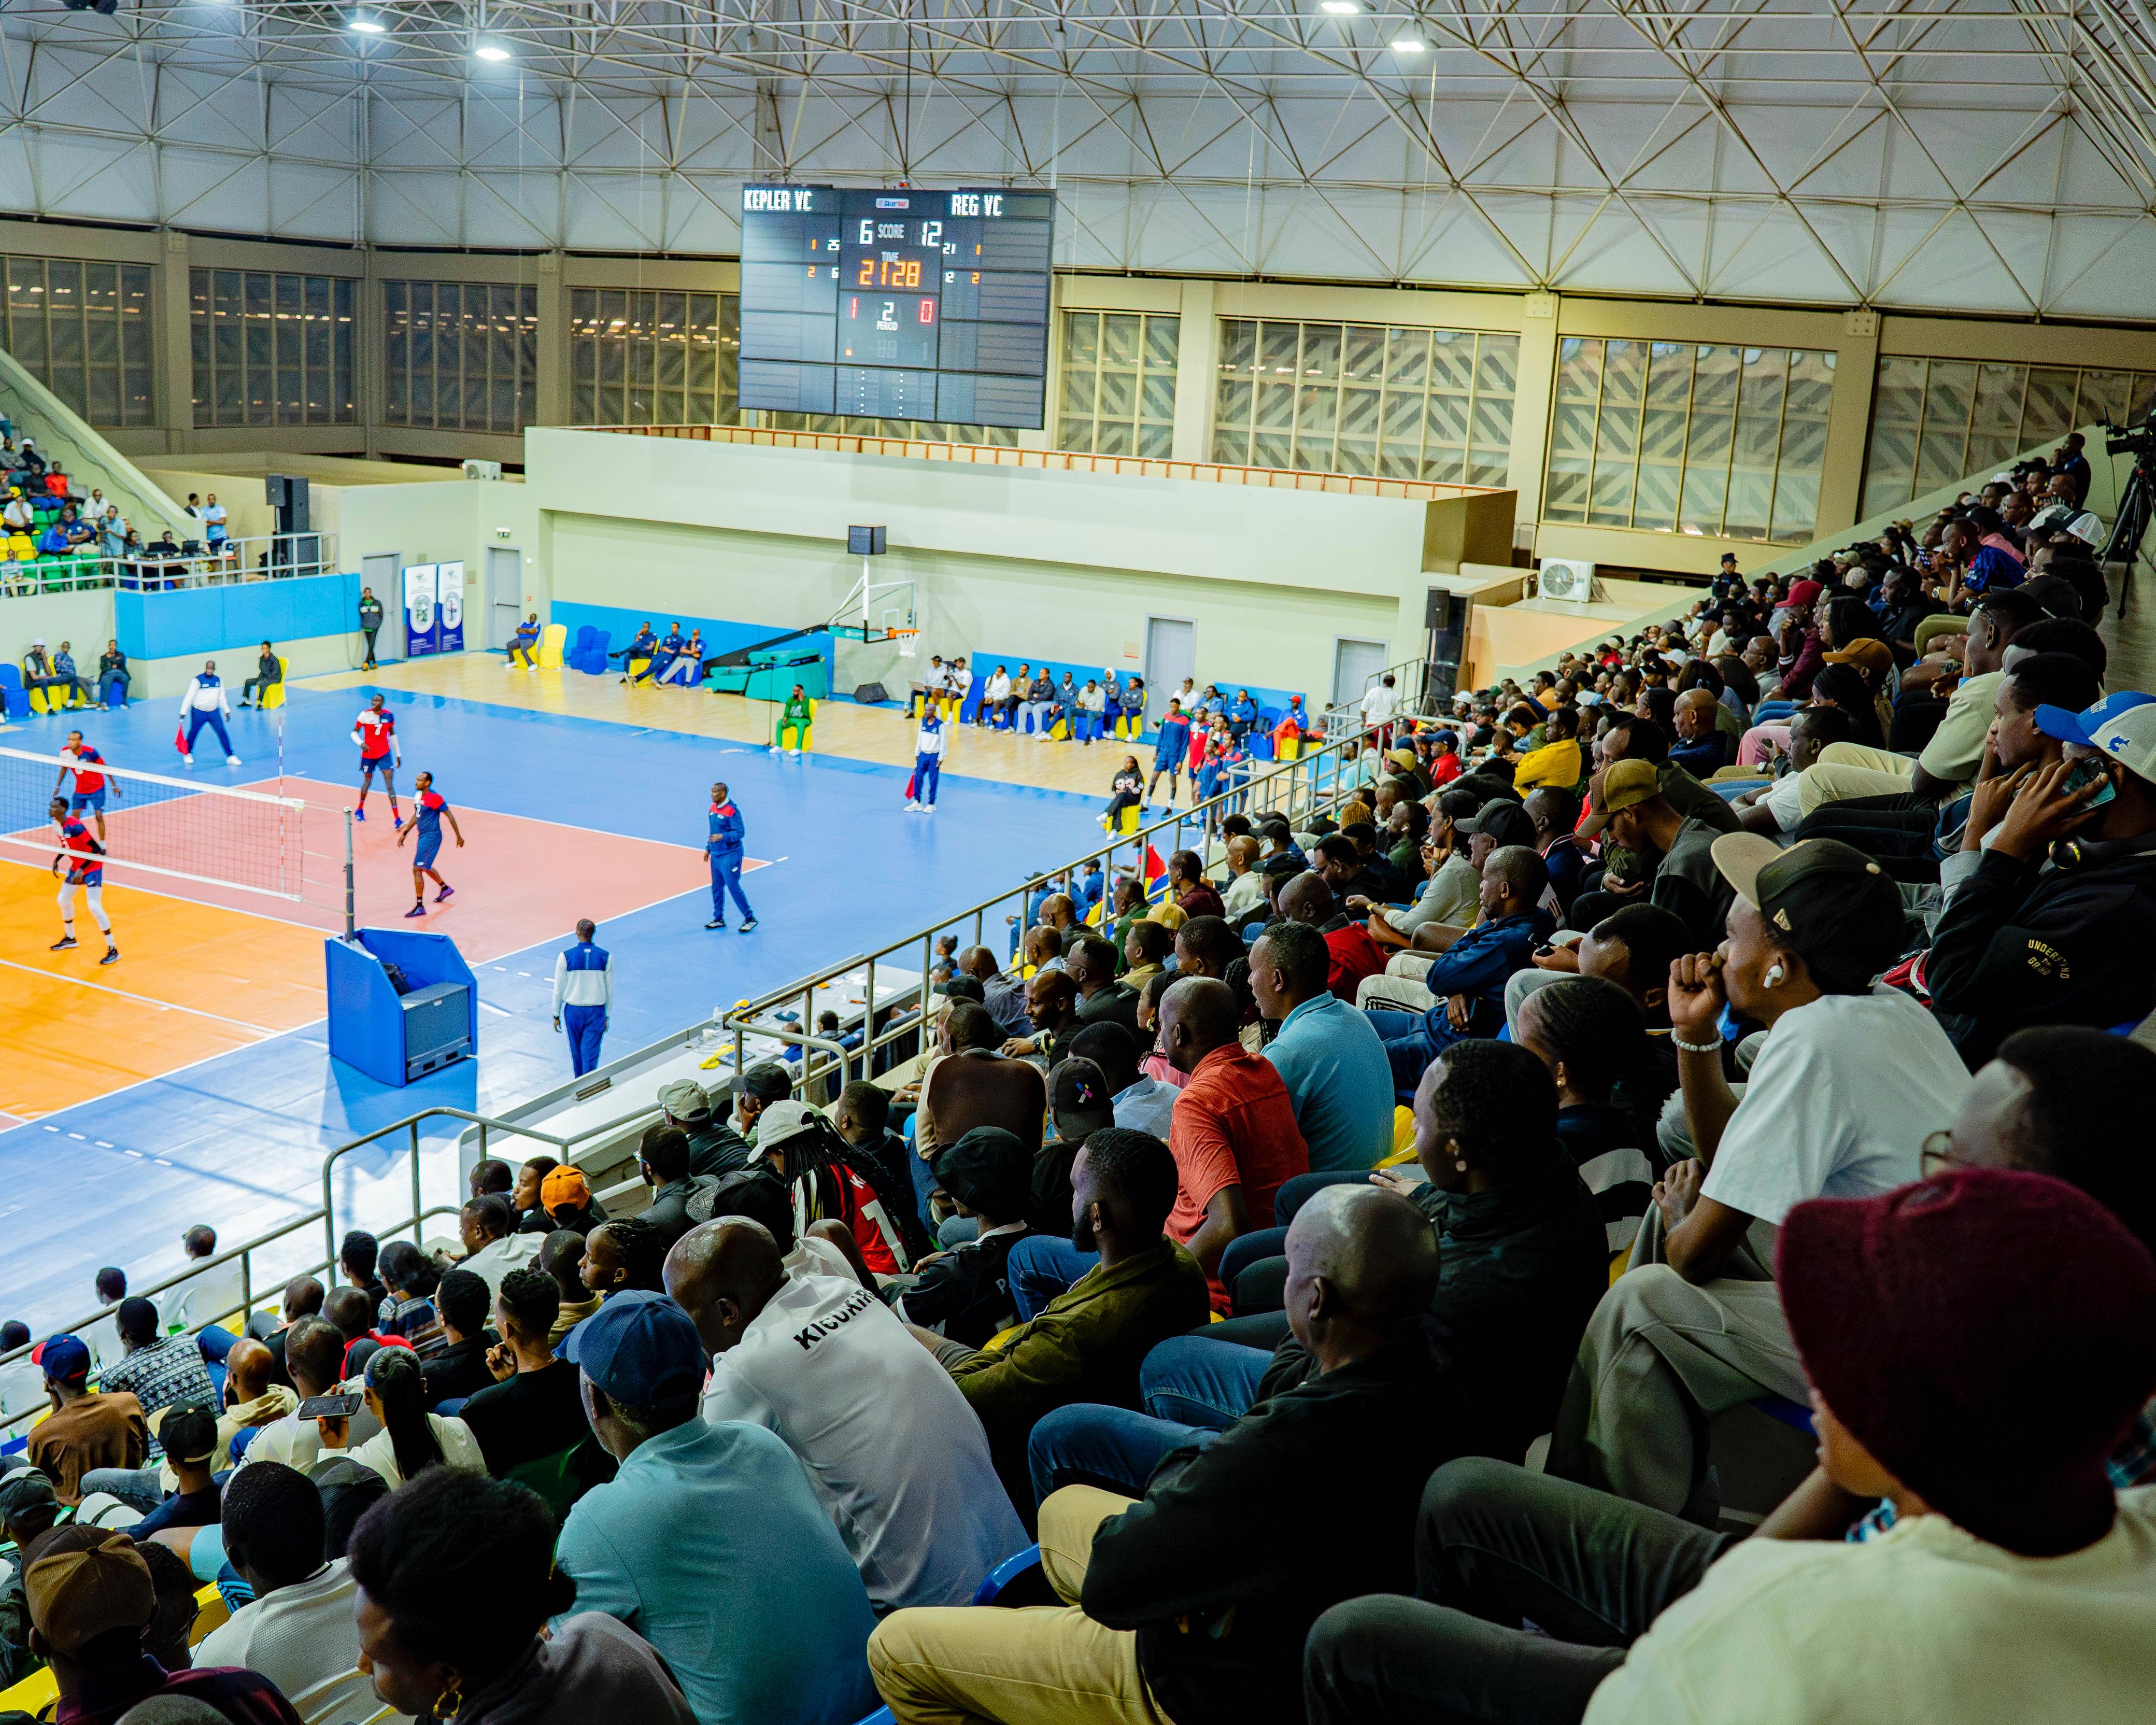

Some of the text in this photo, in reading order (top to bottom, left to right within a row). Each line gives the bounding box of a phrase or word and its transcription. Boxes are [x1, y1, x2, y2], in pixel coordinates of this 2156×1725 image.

[744, 190, 812, 211] KEPLER VC
[951, 194, 1003, 216] REG VC
[859, 219, 873, 245] 6
[877, 223, 904, 238] SCORE
[921, 221, 942, 247] 12
[881, 251, 899, 262] TIME
[942, 243, 956, 254] 21
[807, 266, 816, 278] 2
[971, 272, 980, 285] 2
[851, 297, 858, 319] 1
[882, 301, 894, 321] 2
[919, 300, 934, 324] 0
[876, 320, 898, 331] PERIOD
[374, 723, 383, 736] 7
